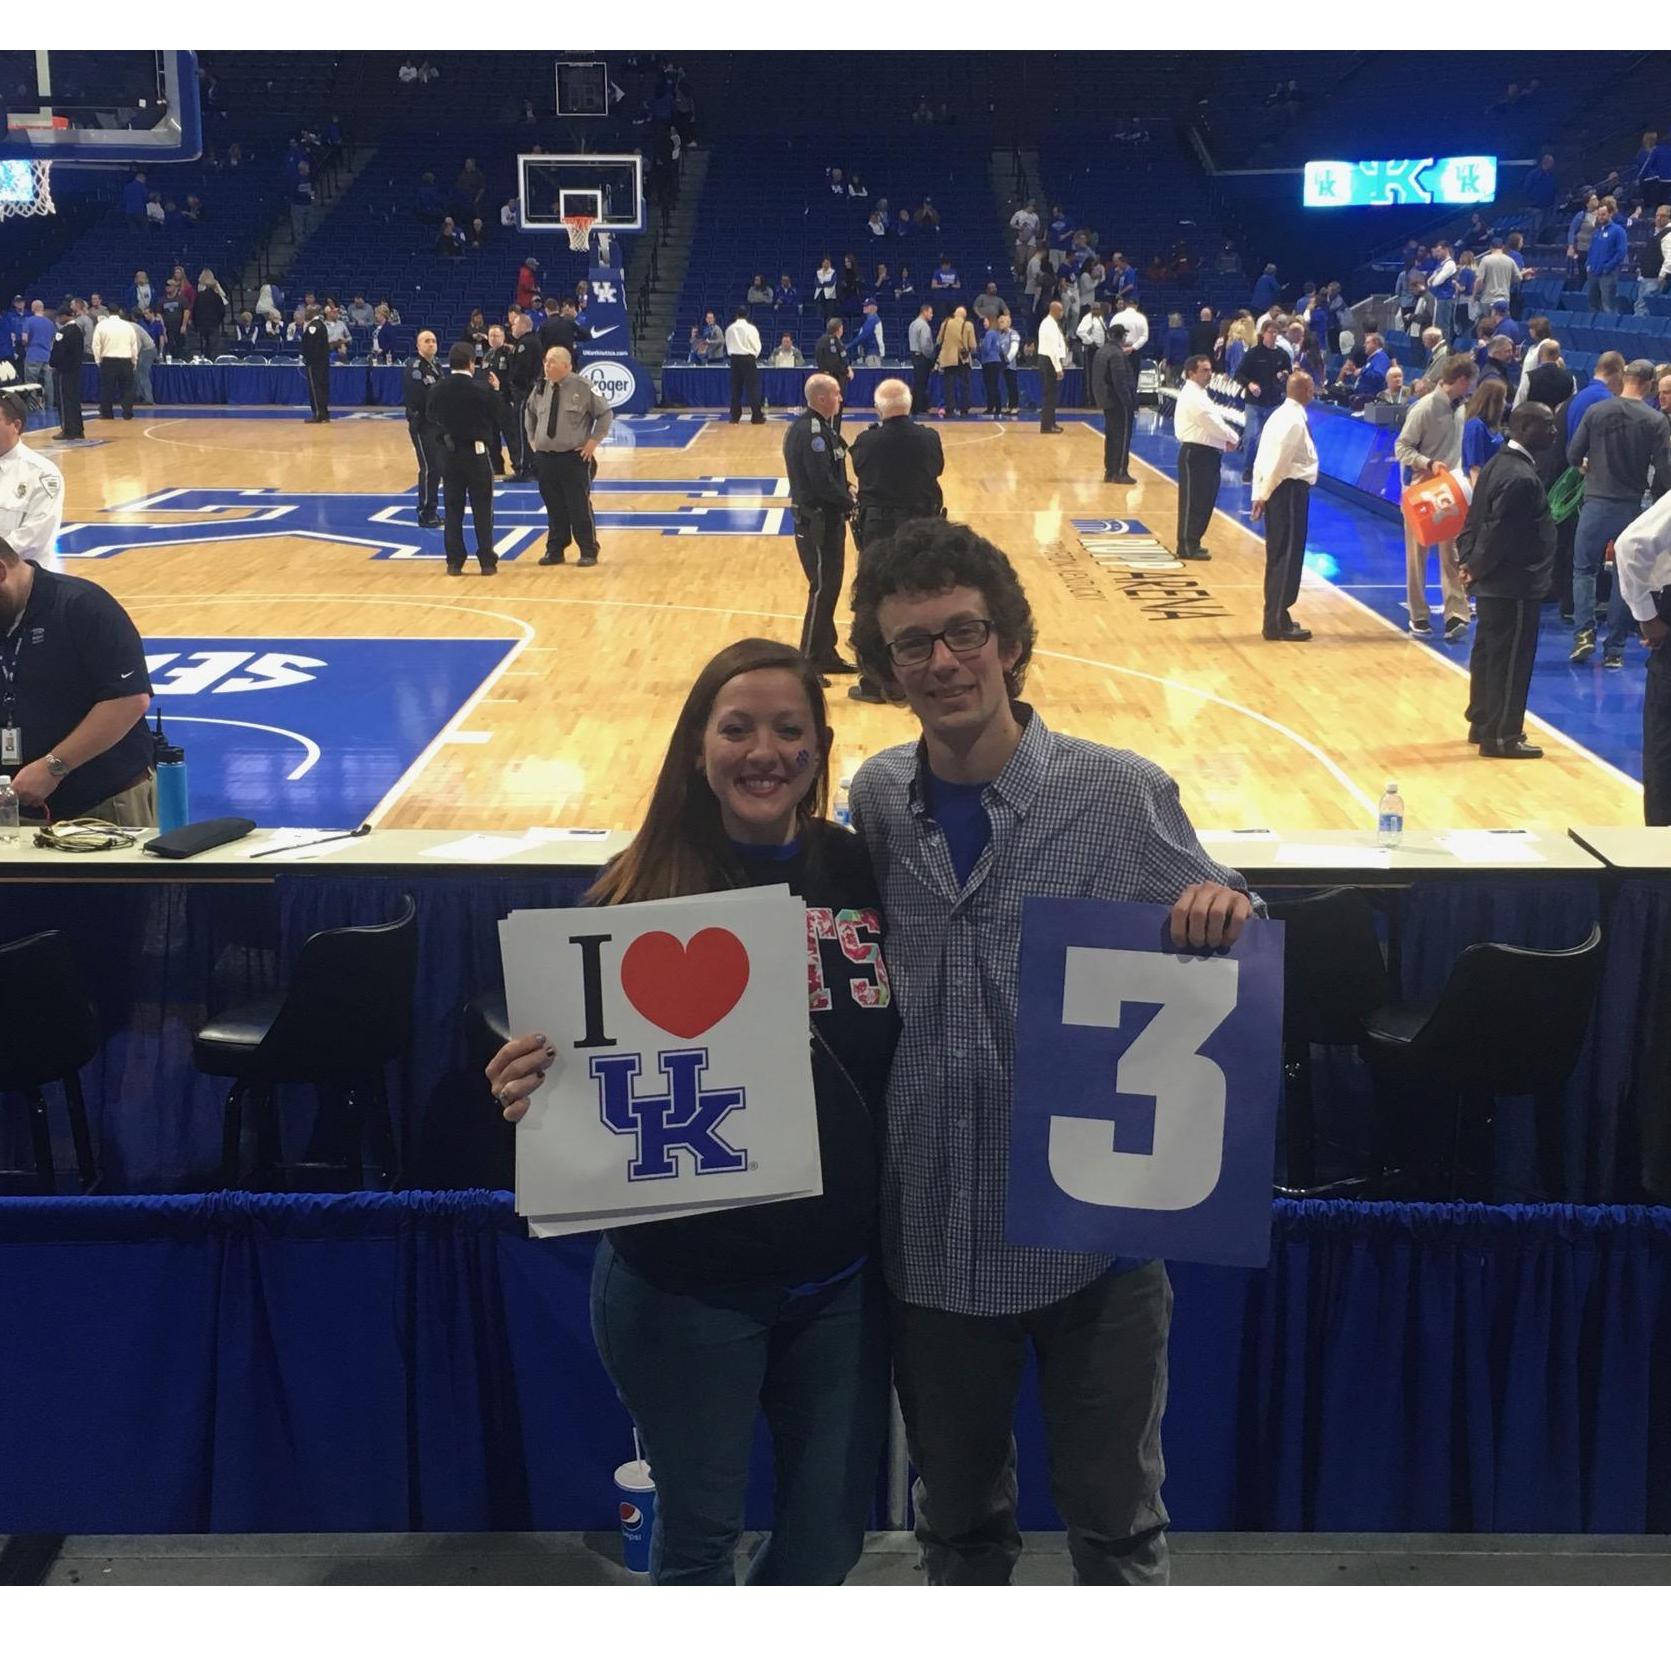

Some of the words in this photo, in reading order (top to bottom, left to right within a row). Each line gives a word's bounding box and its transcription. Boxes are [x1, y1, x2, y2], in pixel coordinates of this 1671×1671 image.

[591, 281, 617, 303] UK
[1107, 568, 1236, 621] ARENA
[146, 650, 328, 695] SE
[568, 933, 617, 1049] I
[588, 1047, 749, 1183] UK
[1047, 945, 1240, 1211] 3
